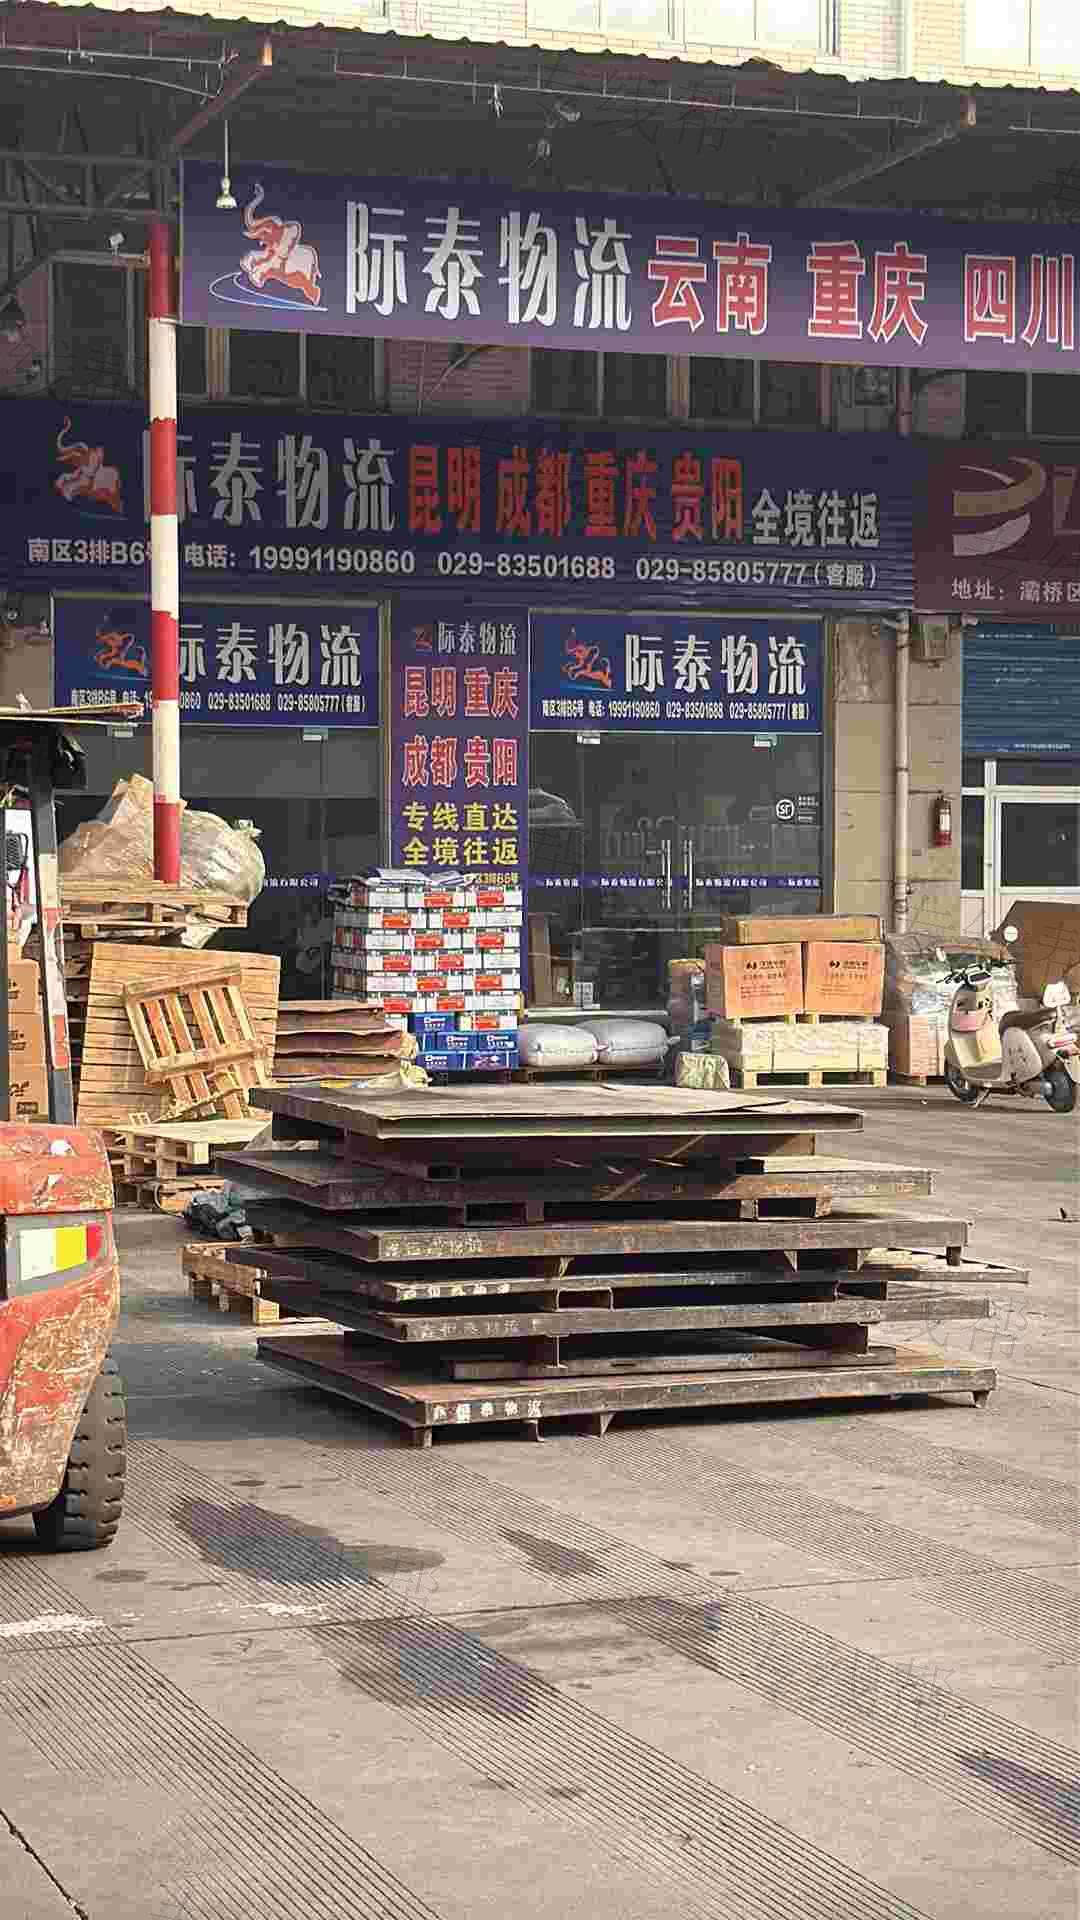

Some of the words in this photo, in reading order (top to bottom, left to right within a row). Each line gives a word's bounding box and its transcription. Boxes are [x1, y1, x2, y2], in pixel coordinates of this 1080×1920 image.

[345, 202, 632, 331] 际泰物流
[647, 234, 773, 335] 云南
[807, 243, 928, 343] 重庆
[962, 252, 1076, 349] 四川
[408, 445, 481, 534] 昆明
[495, 445, 571, 538] 成都
[584, 448, 657, 541] 重庆
[670, 451, 743, 541] 贵阳
[751, 489, 880, 547] 全境往返
[27, 537, 152, 566] 南区3排B6
[248, 545, 415, 572] 19991190860
[438, 551, 615, 578] 029-83501688
[437, 622, 517, 656] 际泰物流
[625, 634, 806, 695] 际泰物流
[207, 692, 271, 711] 029-83501688
[403, 666, 457, 717] 昆明
[464, 666, 519, 719] 重庆
[402, 735, 457, 787] 成都
[463, 735, 518, 788] 贵阳
[402, 801, 518, 832] 专线直达
[402, 837, 519, 866] 全境往返
